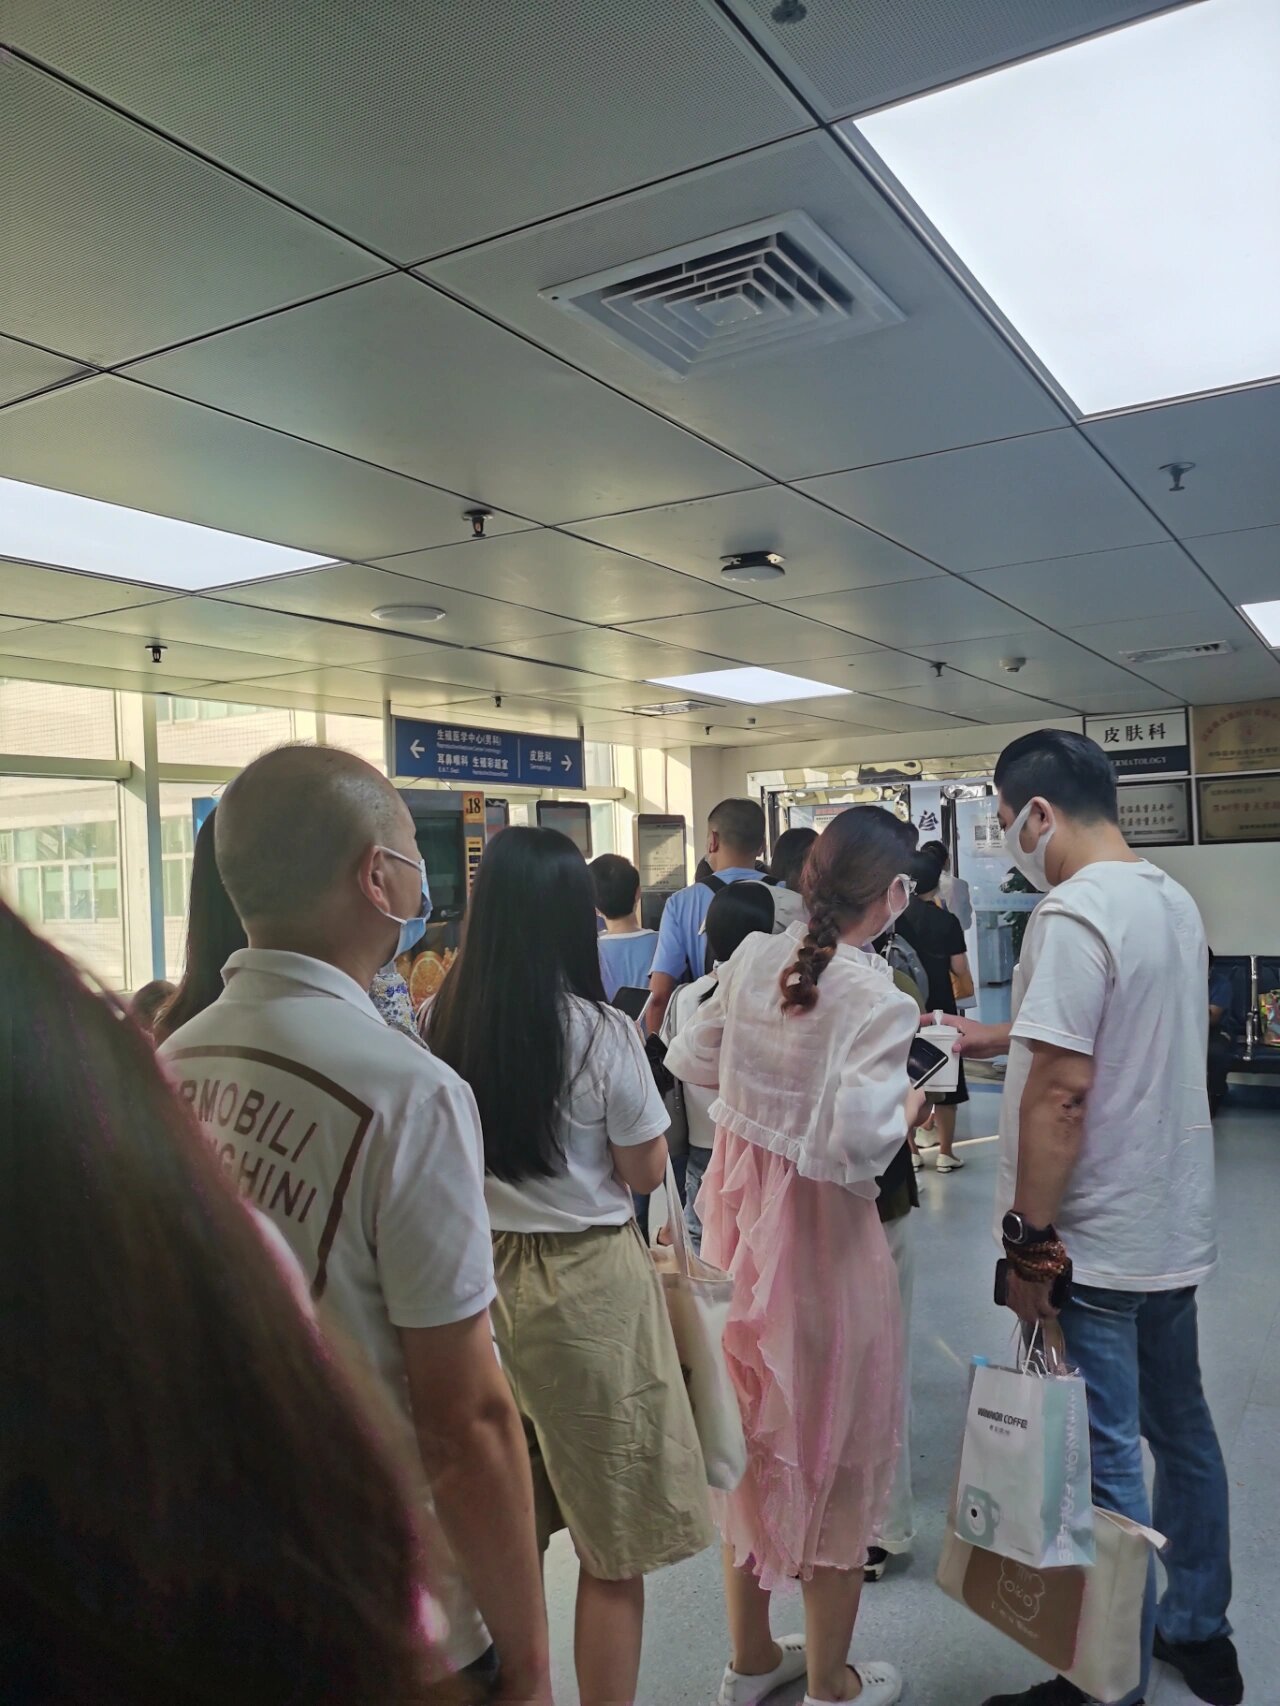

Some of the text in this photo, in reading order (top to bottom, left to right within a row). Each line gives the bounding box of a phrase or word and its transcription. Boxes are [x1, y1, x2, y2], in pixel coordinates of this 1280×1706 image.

[1104, 722, 1167, 744] 皮肤科
[437, 753, 469, 767] 耳鼻喉科
